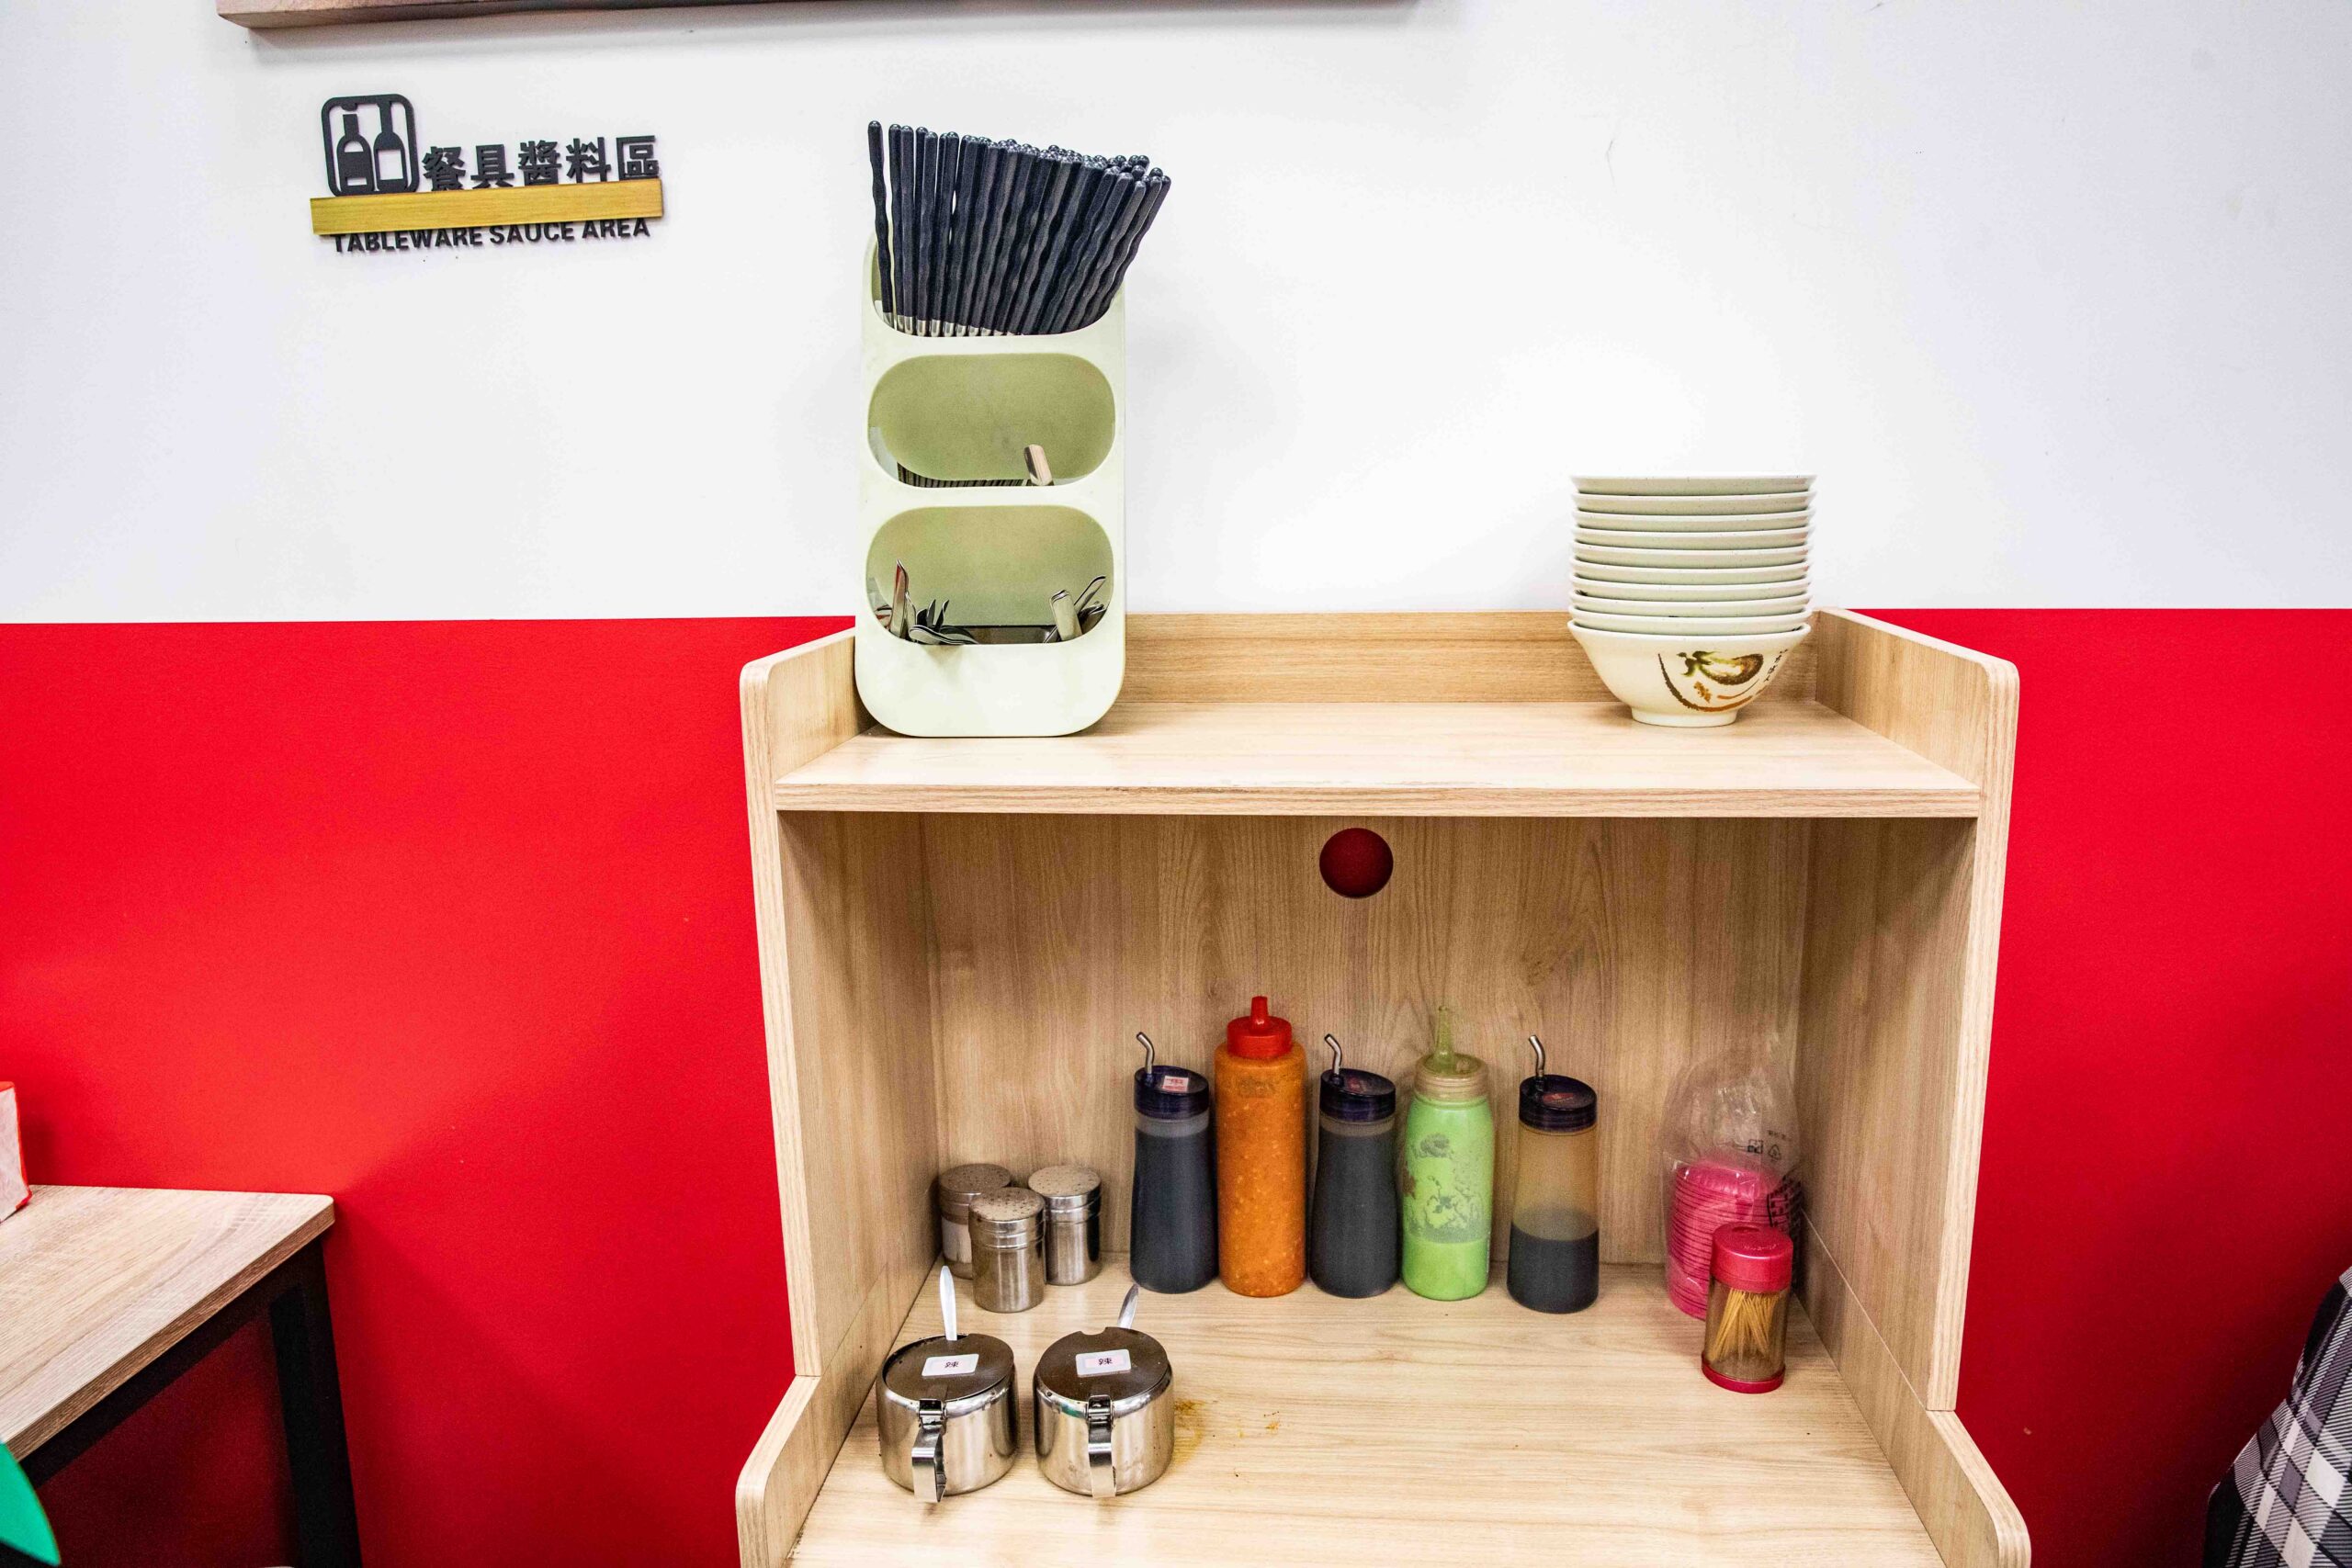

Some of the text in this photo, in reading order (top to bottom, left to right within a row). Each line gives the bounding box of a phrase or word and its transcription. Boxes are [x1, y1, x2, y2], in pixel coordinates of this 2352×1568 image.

[422, 135, 660, 191] 餐具醬料區
[330, 217, 650, 254] TABLEWARE SAUCE AREA
